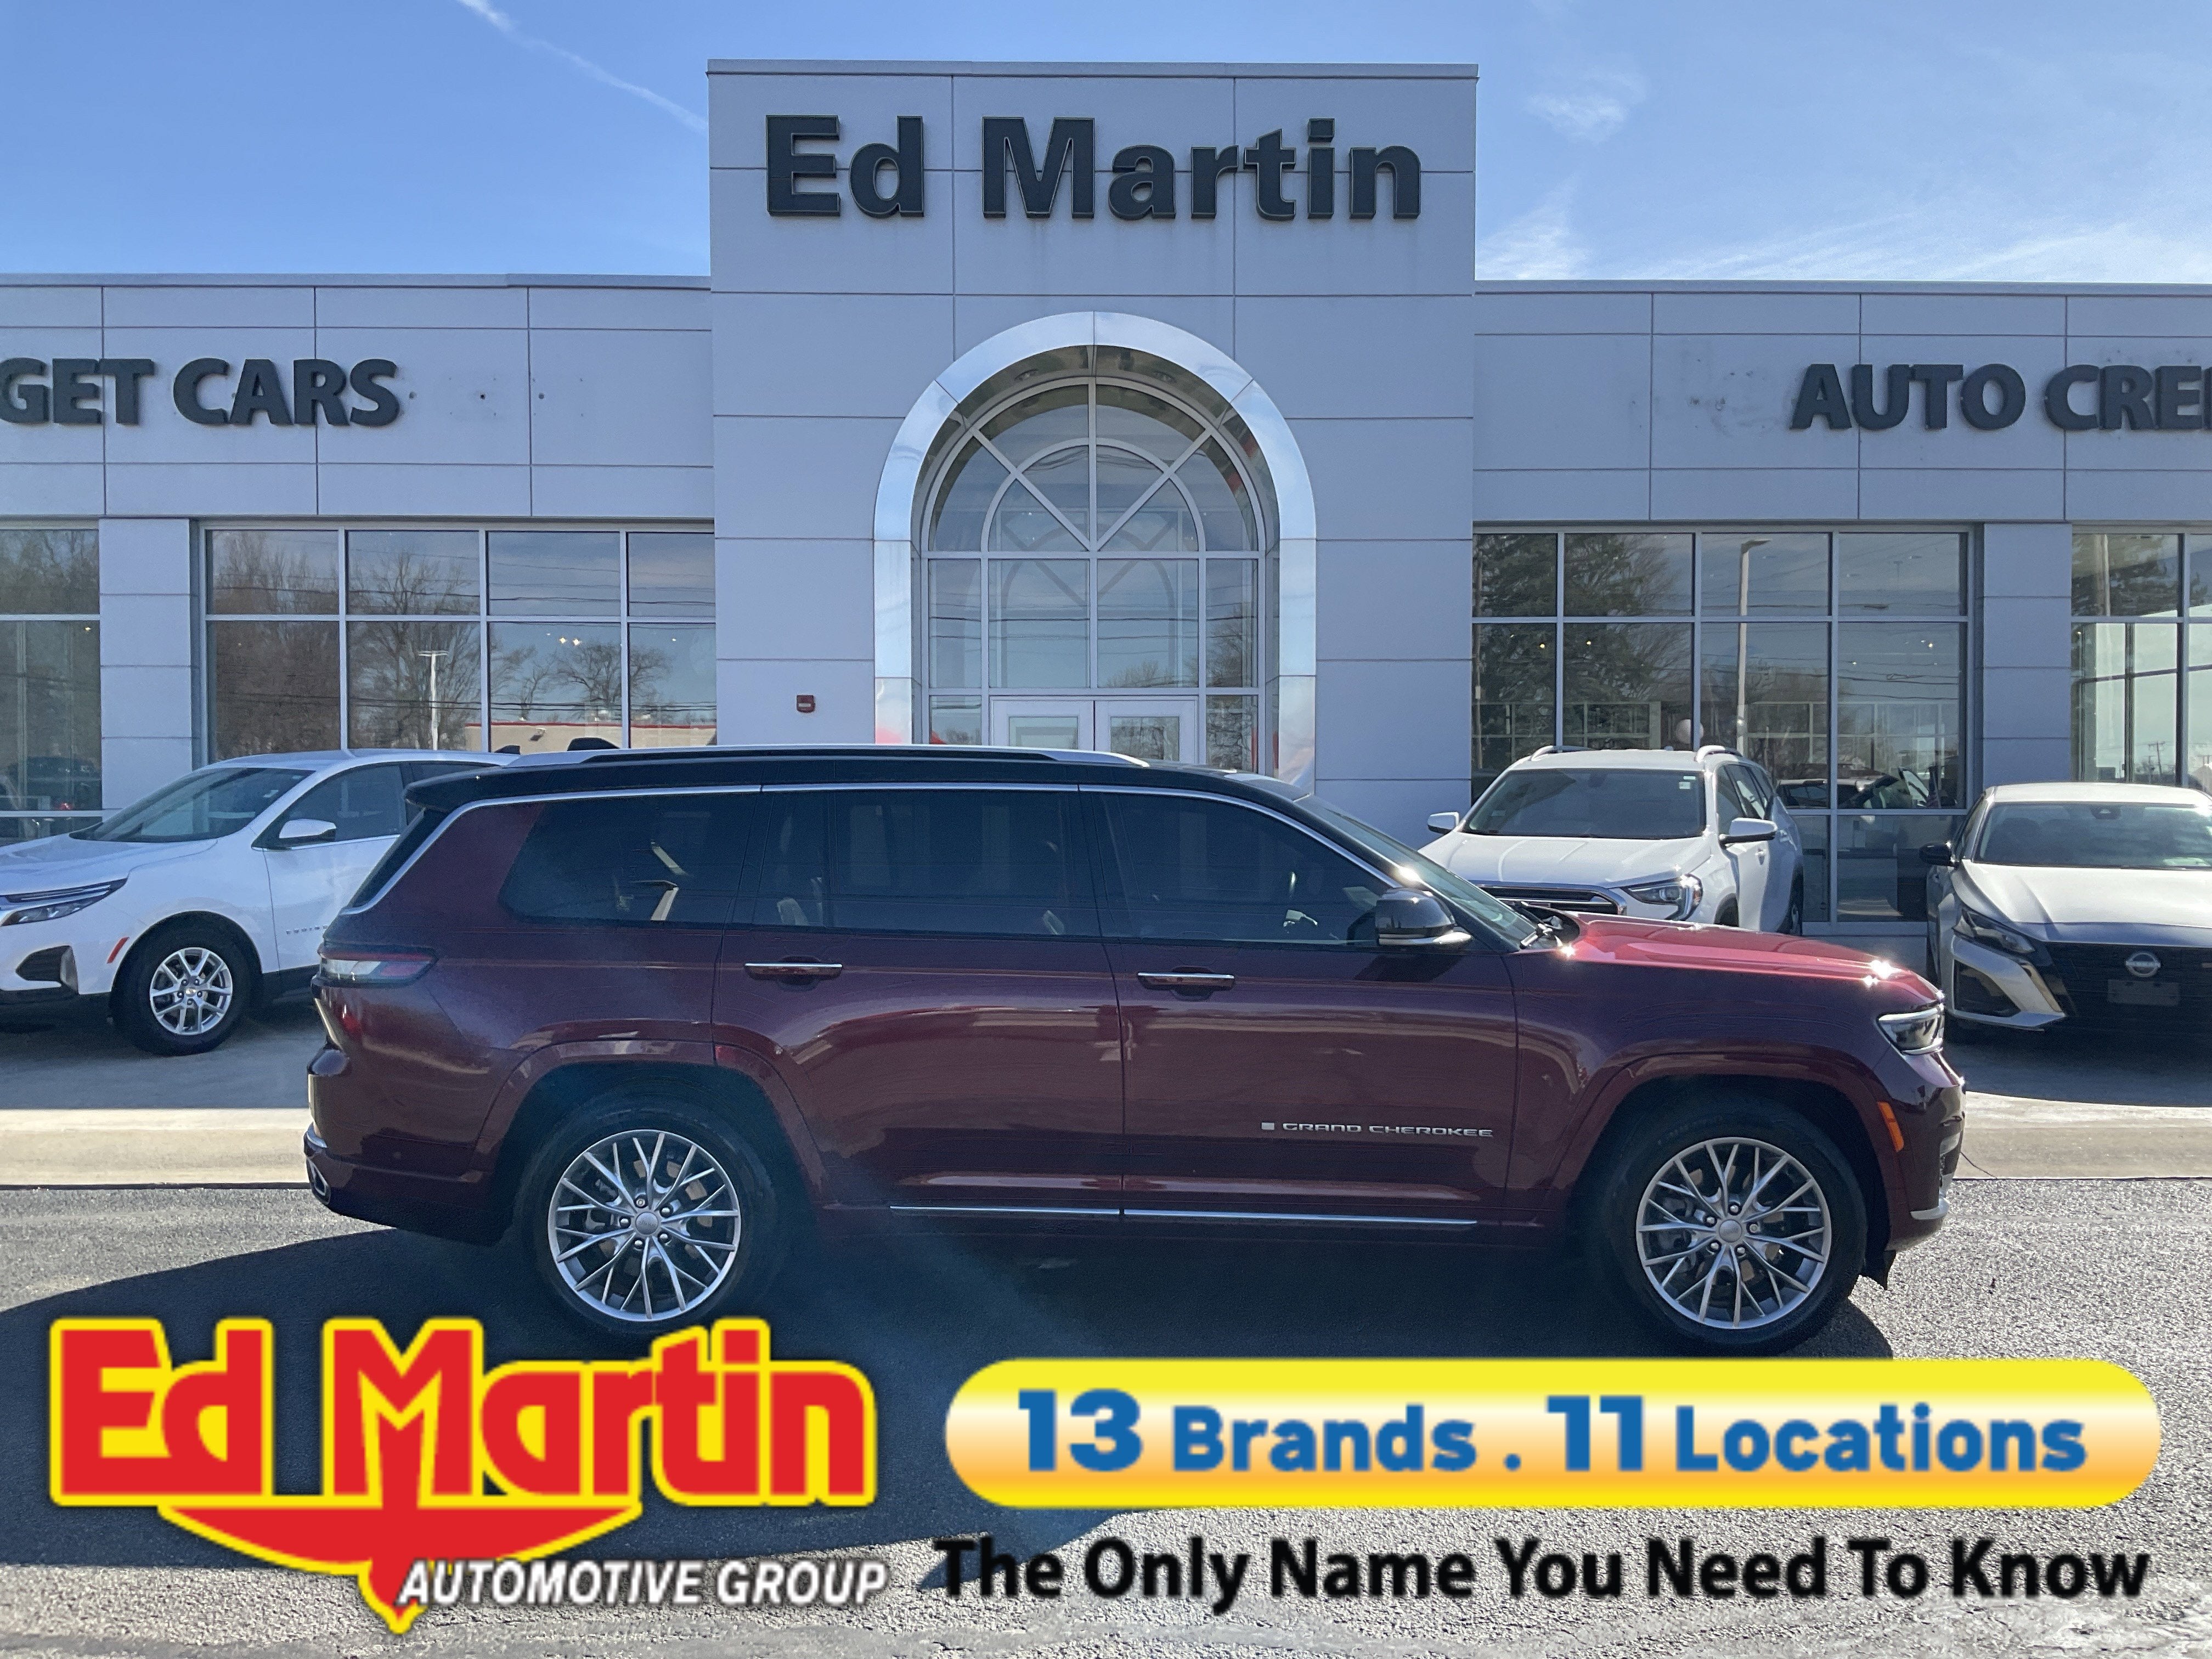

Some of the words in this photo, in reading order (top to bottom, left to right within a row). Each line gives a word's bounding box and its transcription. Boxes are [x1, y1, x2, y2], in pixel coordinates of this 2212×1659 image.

[766, 115, 925, 217] Ed
[982, 117, 1421, 221] Martin
[0, 357, 155, 425] GET
[173, 357, 400, 426] CARS
[1790, 364, 2026, 431] AUTO
[2044, 365, 2212, 431] CRE
[1282, 1122, 1362, 1133] GRAND
[1369, 1125, 1493, 1137] CHEROKEE
